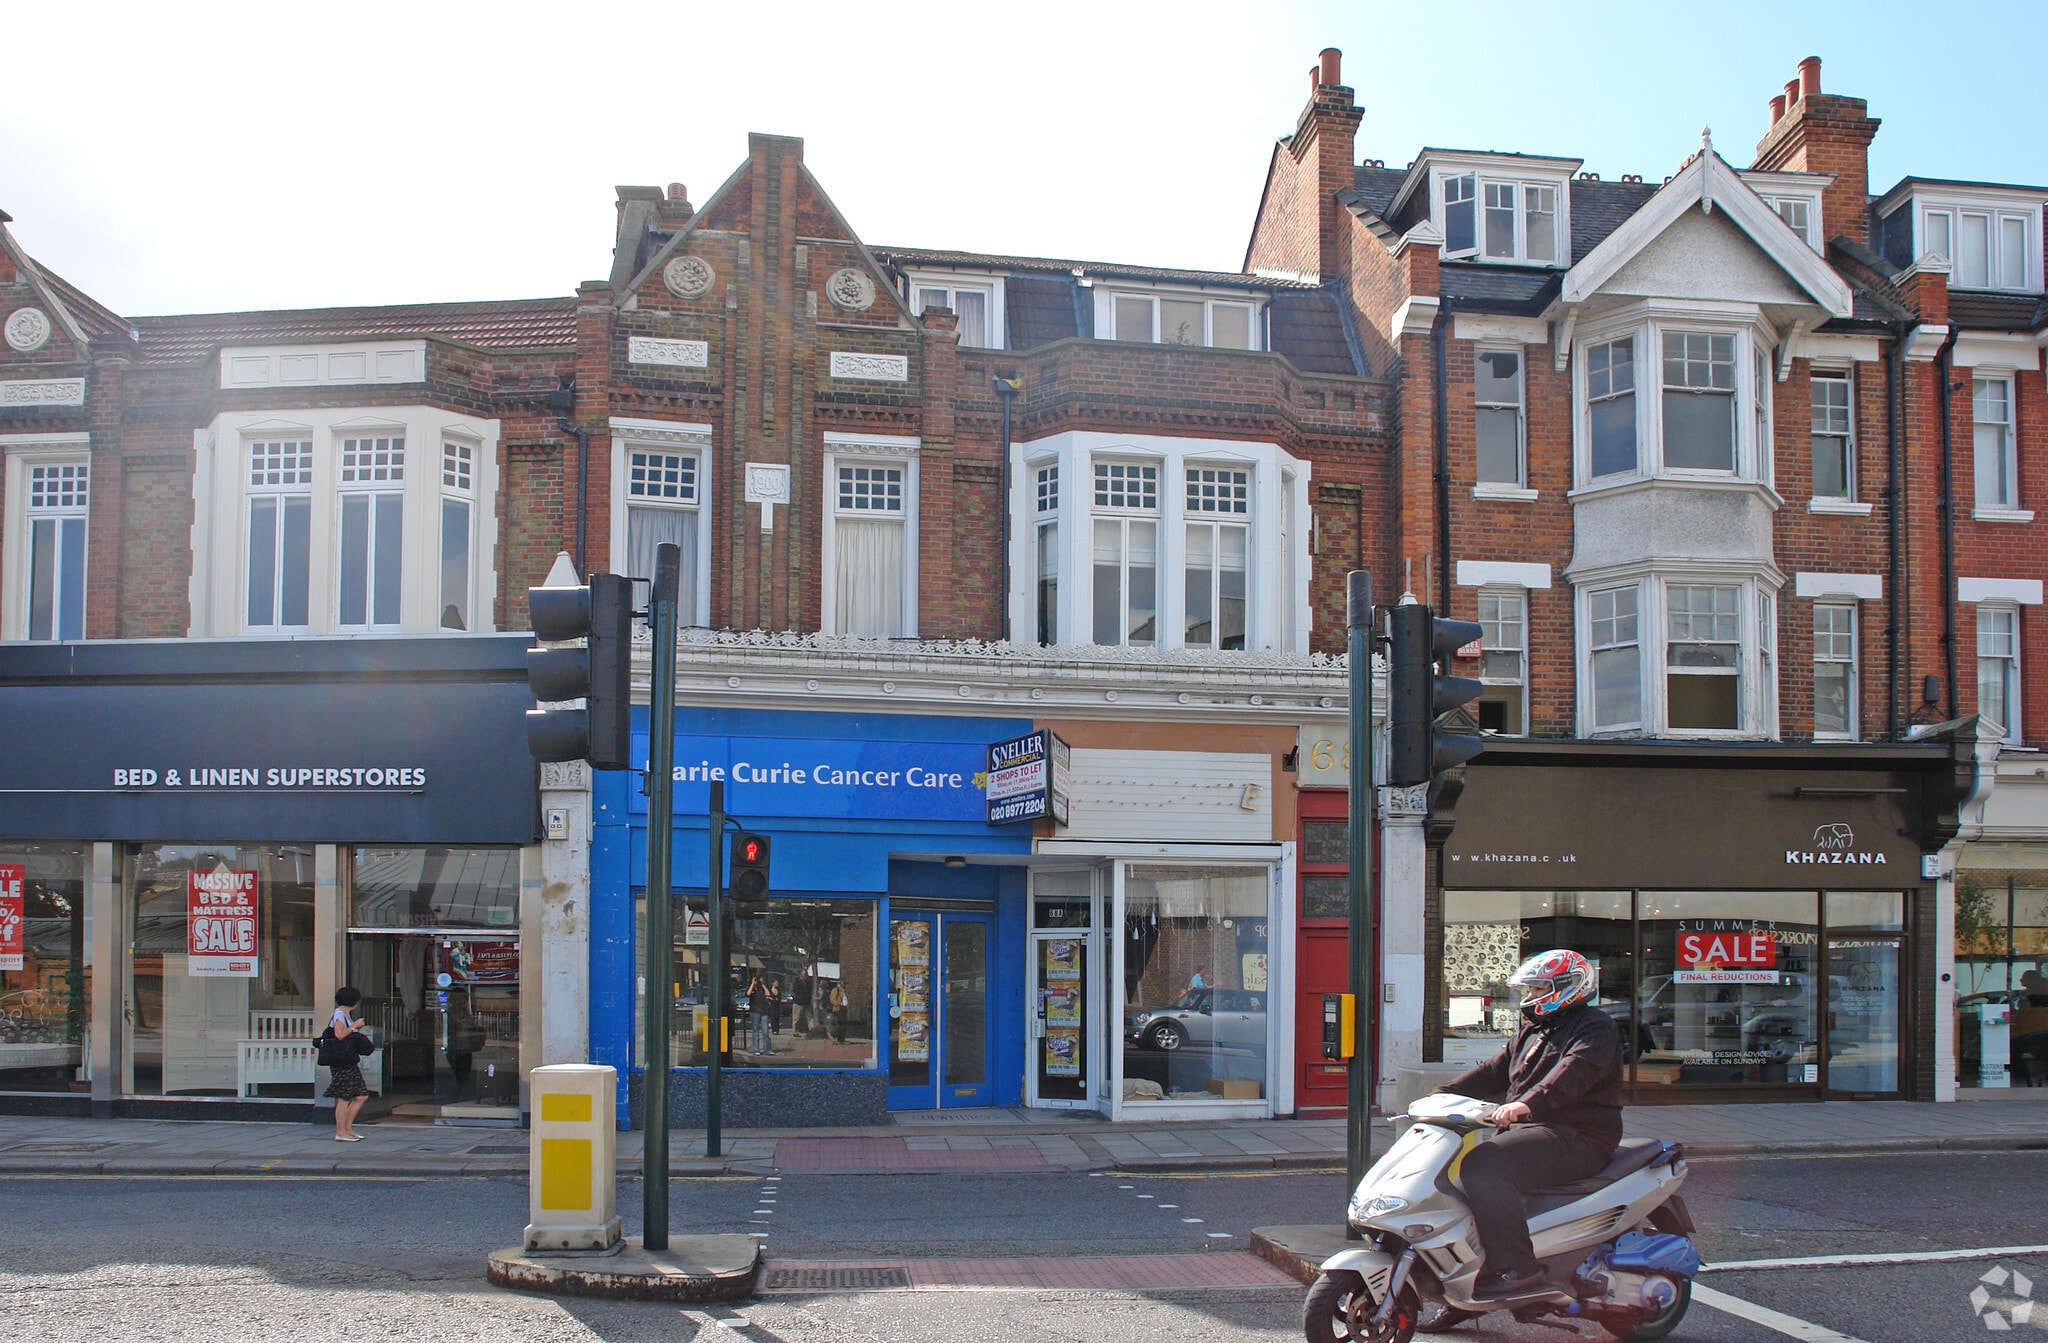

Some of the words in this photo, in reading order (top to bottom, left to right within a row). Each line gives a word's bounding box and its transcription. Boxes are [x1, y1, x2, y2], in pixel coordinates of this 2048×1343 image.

[992, 736, 1044, 770] SNELLER
[1000, 753, 1040, 769] COMMERCIAL
[114, 768, 158, 786] BED
[165, 769, 182, 786] &
[190, 768, 259, 786] LINEN
[266, 768, 426, 786] SUPERSTORES
[645, 760, 725, 782] arie
[732, 762, 806, 784] Curie
[813, 764, 900, 786] Cancer
[906, 767, 962, 788] Care
[991, 774, 996, 784] 2
[996, 768, 1019, 782] SHOPS
[1020, 766, 1029, 777] TO
[1030, 763, 1042, 774] LET
[991, 805, 1005, 820] 020
[1005, 800, 1025, 817] 8977
[1025, 797, 1045, 814] 2204
[1785, 850, 1887, 864] KHAZANA
[194, 873, 253, 890] MASSIVE
[199, 892, 231, 904] BED
[237, 892, 248, 904] &
[193, 906, 253, 915] MATTRESS
[1679, 920, 1776, 931] SUMMER
[192, 916, 254, 953] SALE
[1683, 936, 1767, 962] SALE
[1680, 973, 1708, 981] FINAL
[1711, 973, 1773, 981] REDUCTIONS
